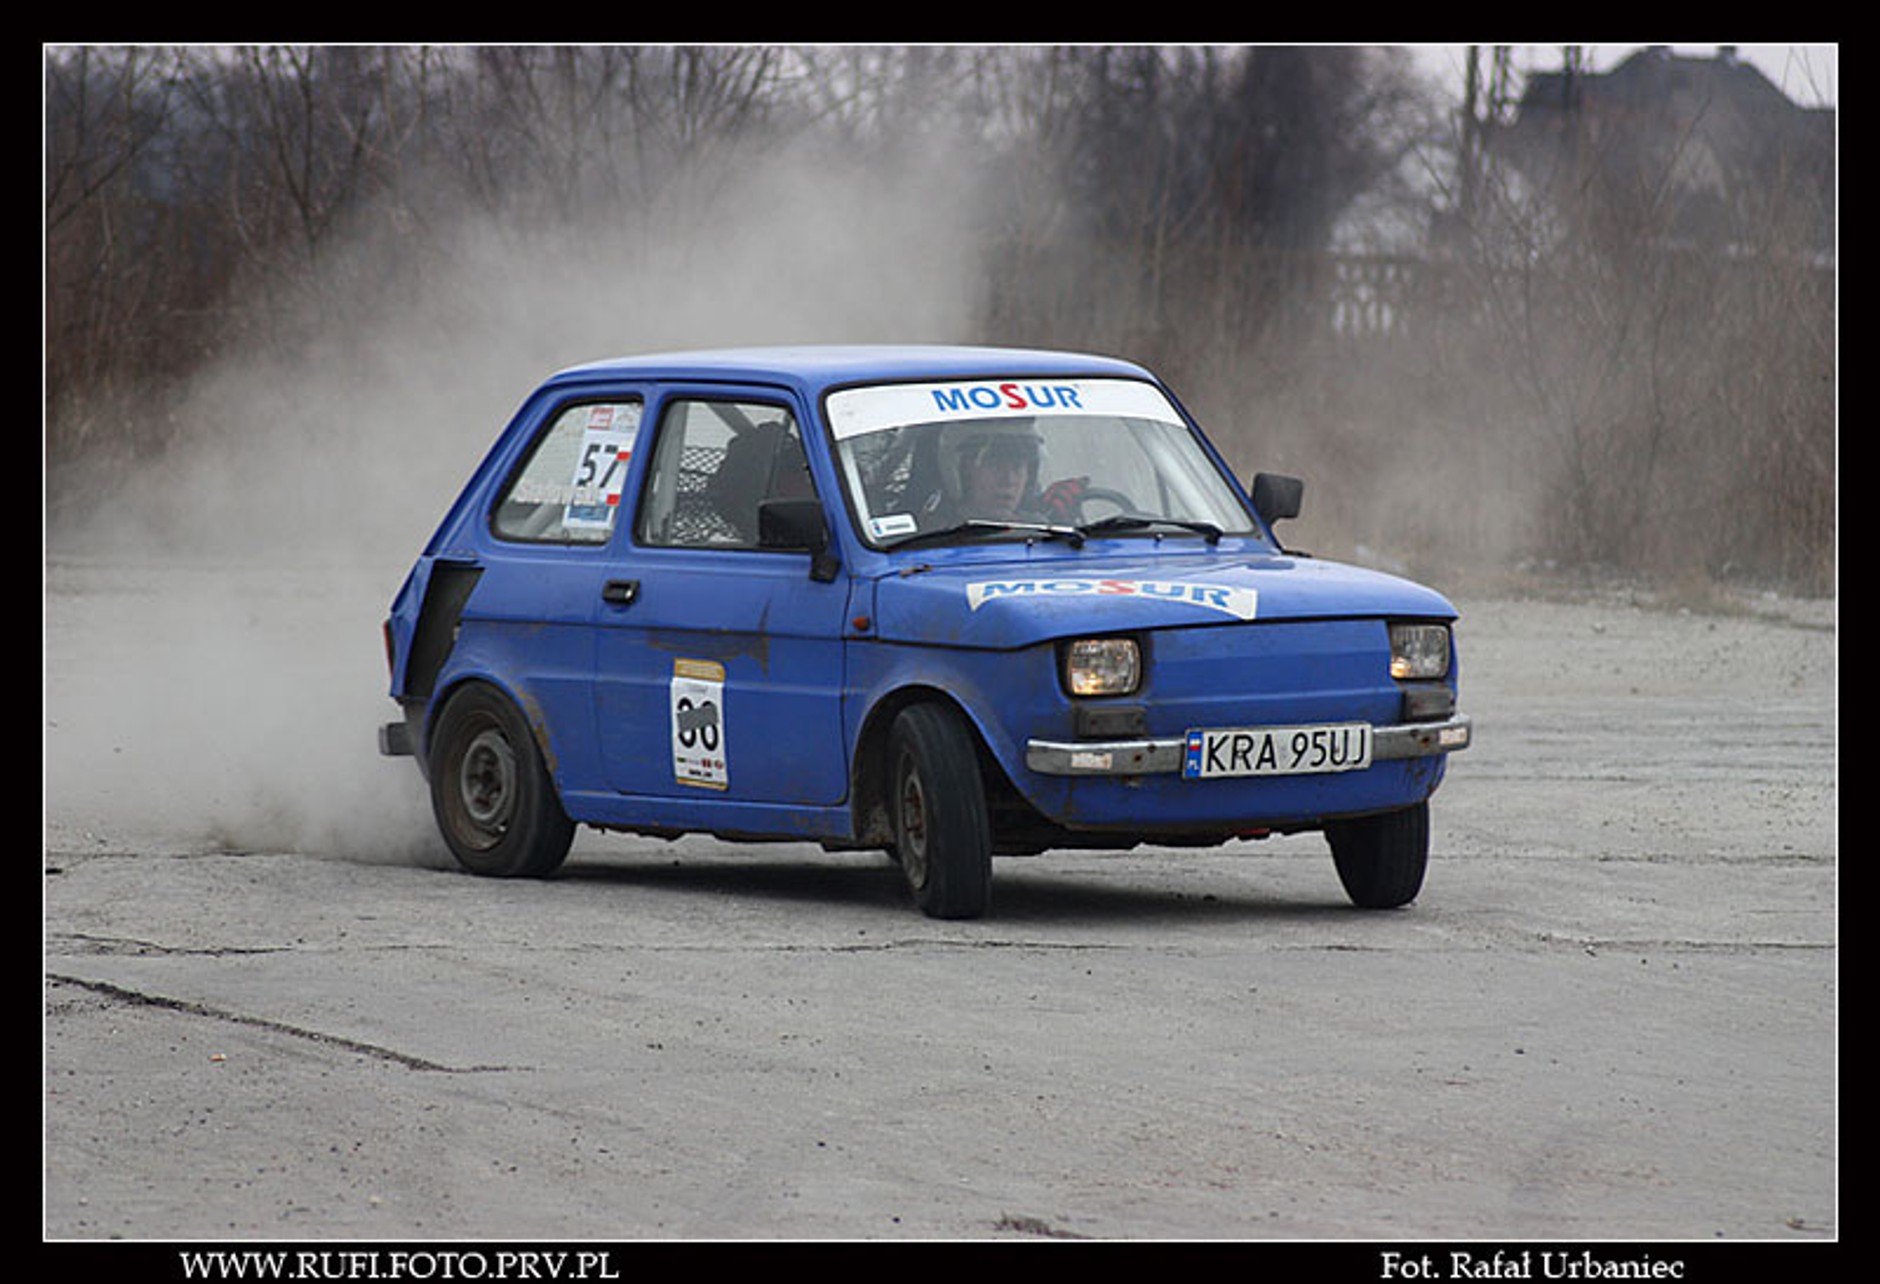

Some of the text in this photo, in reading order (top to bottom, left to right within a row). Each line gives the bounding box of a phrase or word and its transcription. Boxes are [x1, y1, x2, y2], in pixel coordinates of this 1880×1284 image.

[931, 383, 1083, 412] MOSUR
[576, 444, 619, 488] 57
[982, 580, 1230, 608] MOSUR
[1206, 729, 1366, 772] KRA 95UJ
